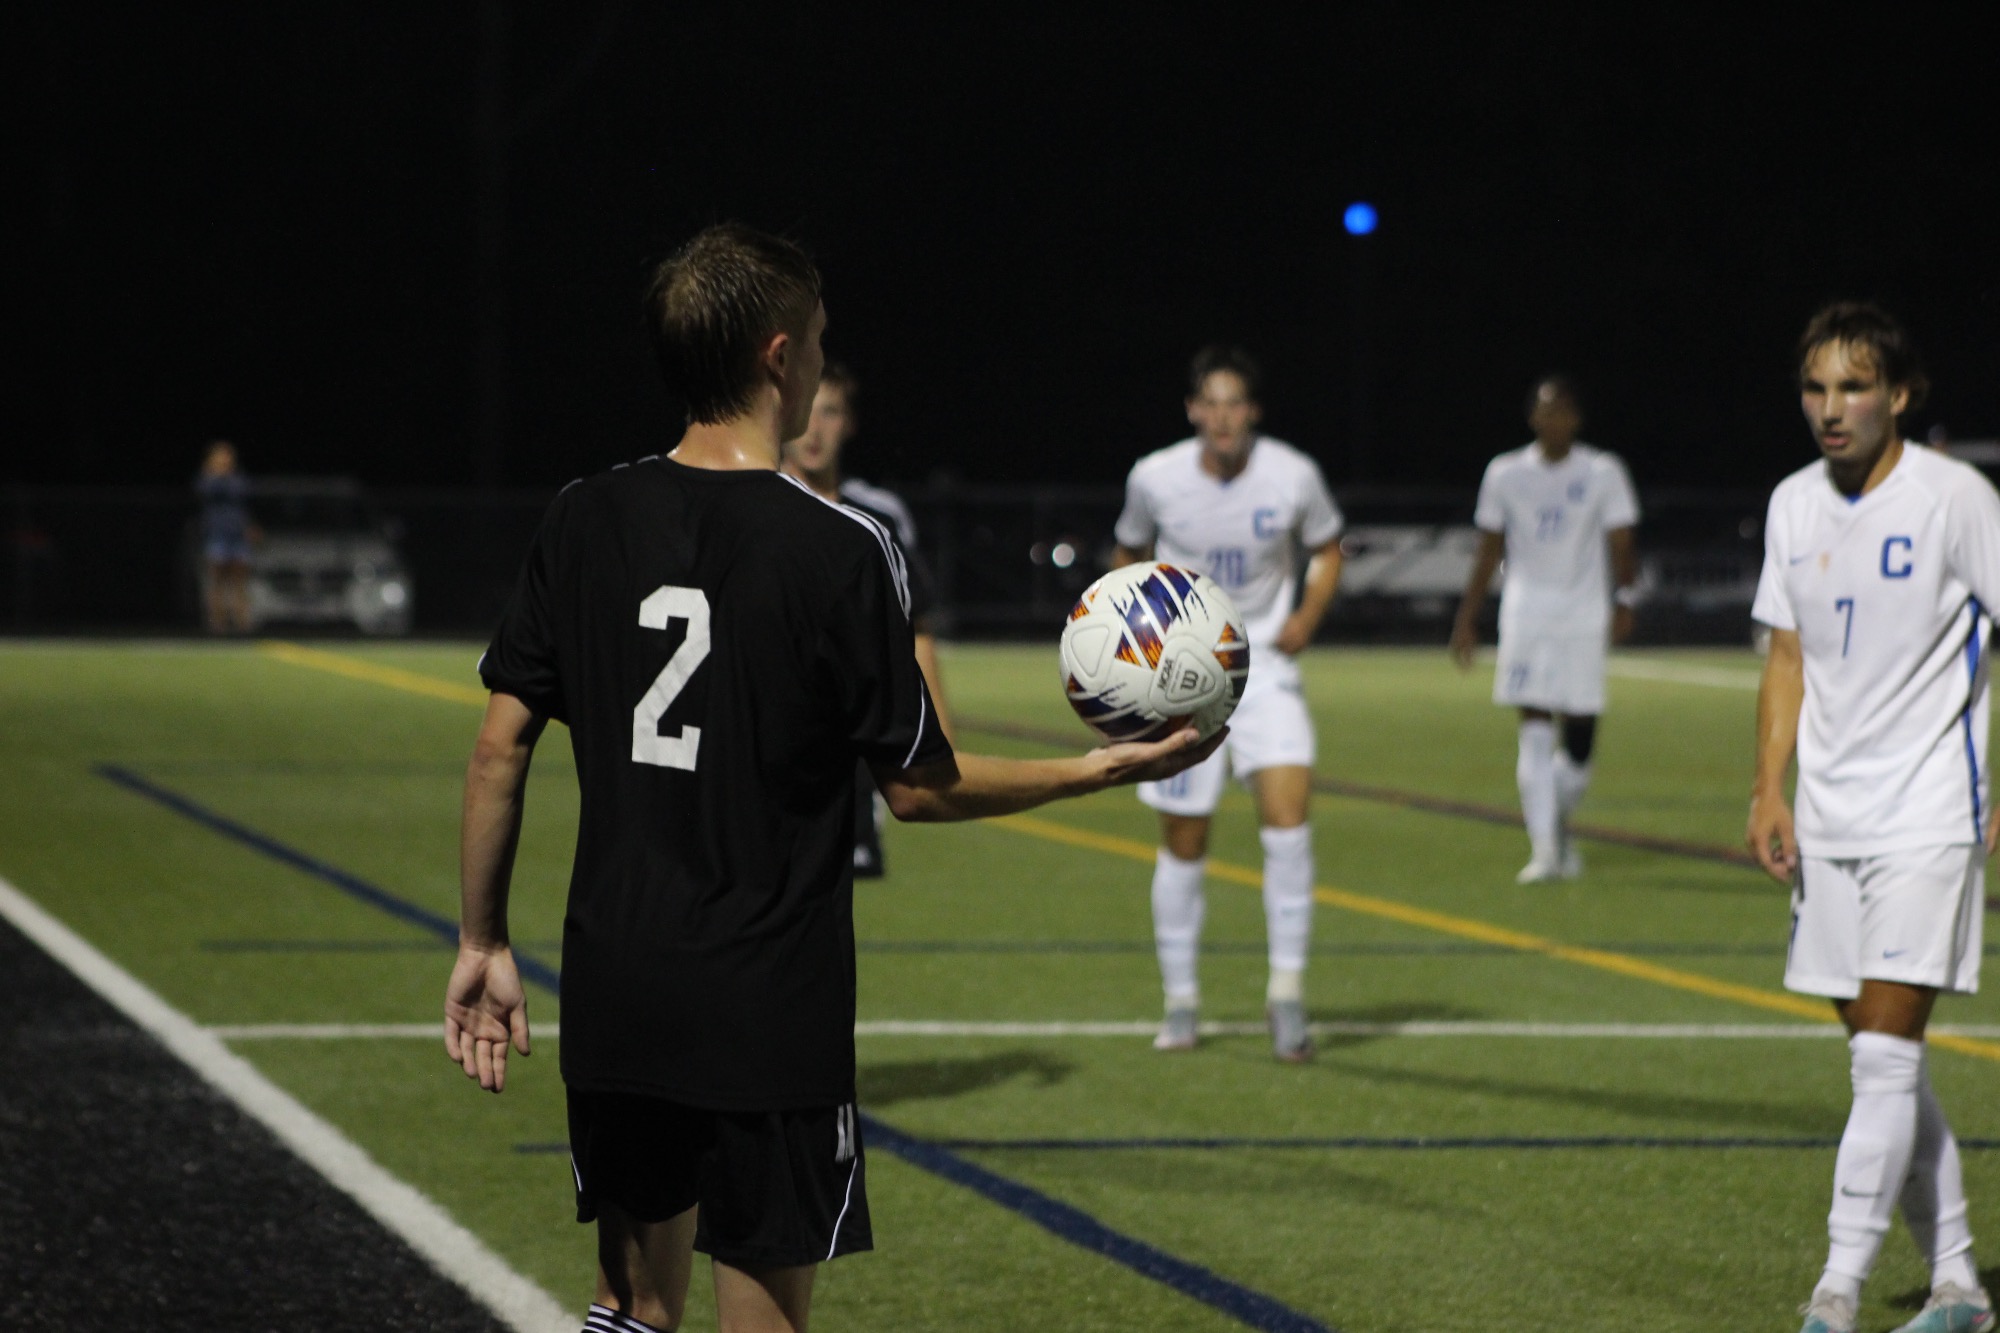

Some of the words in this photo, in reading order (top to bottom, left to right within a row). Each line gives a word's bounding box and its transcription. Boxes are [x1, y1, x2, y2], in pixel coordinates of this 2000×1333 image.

[1253, 507, 1276, 540] C
[1880, 536, 1913, 579] C
[1835, 598, 1854, 659] 7
[632, 584, 711, 772] 2
[1157, 659, 1174, 690] NCAA
